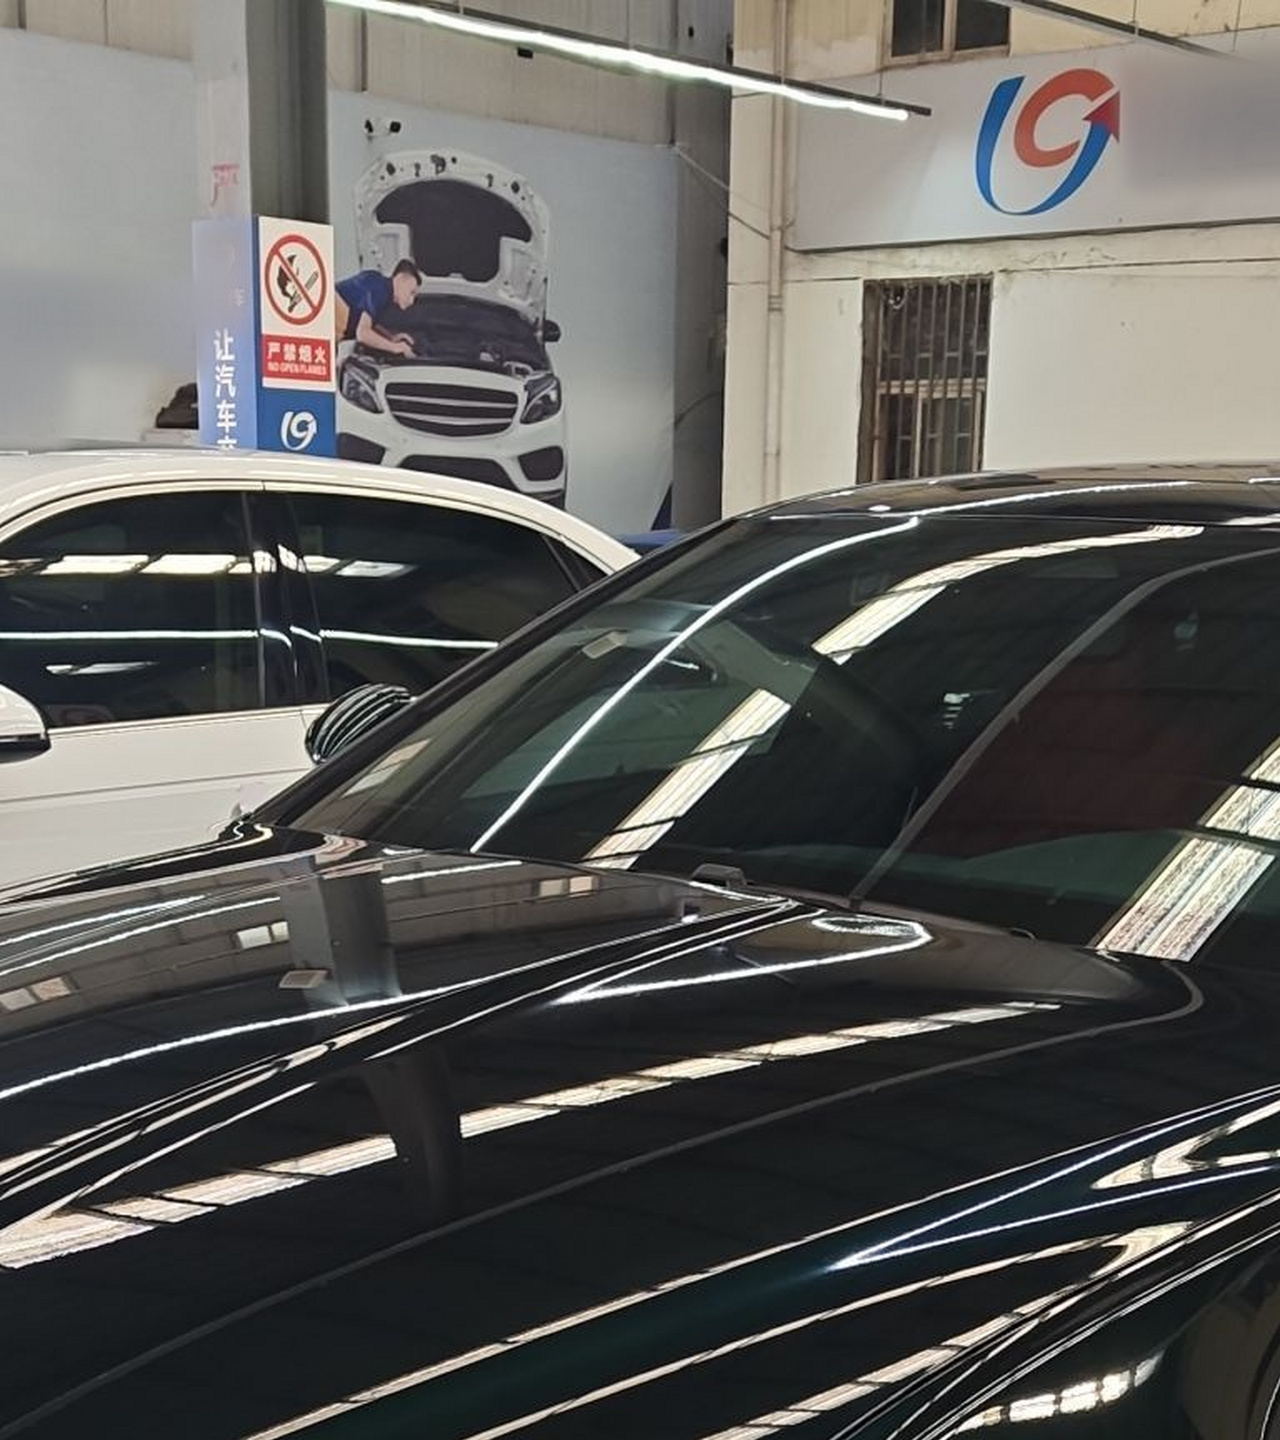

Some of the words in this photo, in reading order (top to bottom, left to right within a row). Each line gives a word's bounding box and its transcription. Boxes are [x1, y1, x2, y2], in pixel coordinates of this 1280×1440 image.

[266, 341, 326, 364] 严禁烟火
[267, 361, 279, 372] NO
[280, 362, 300, 374] OPEN
[301, 364, 327, 376] FLAMES
